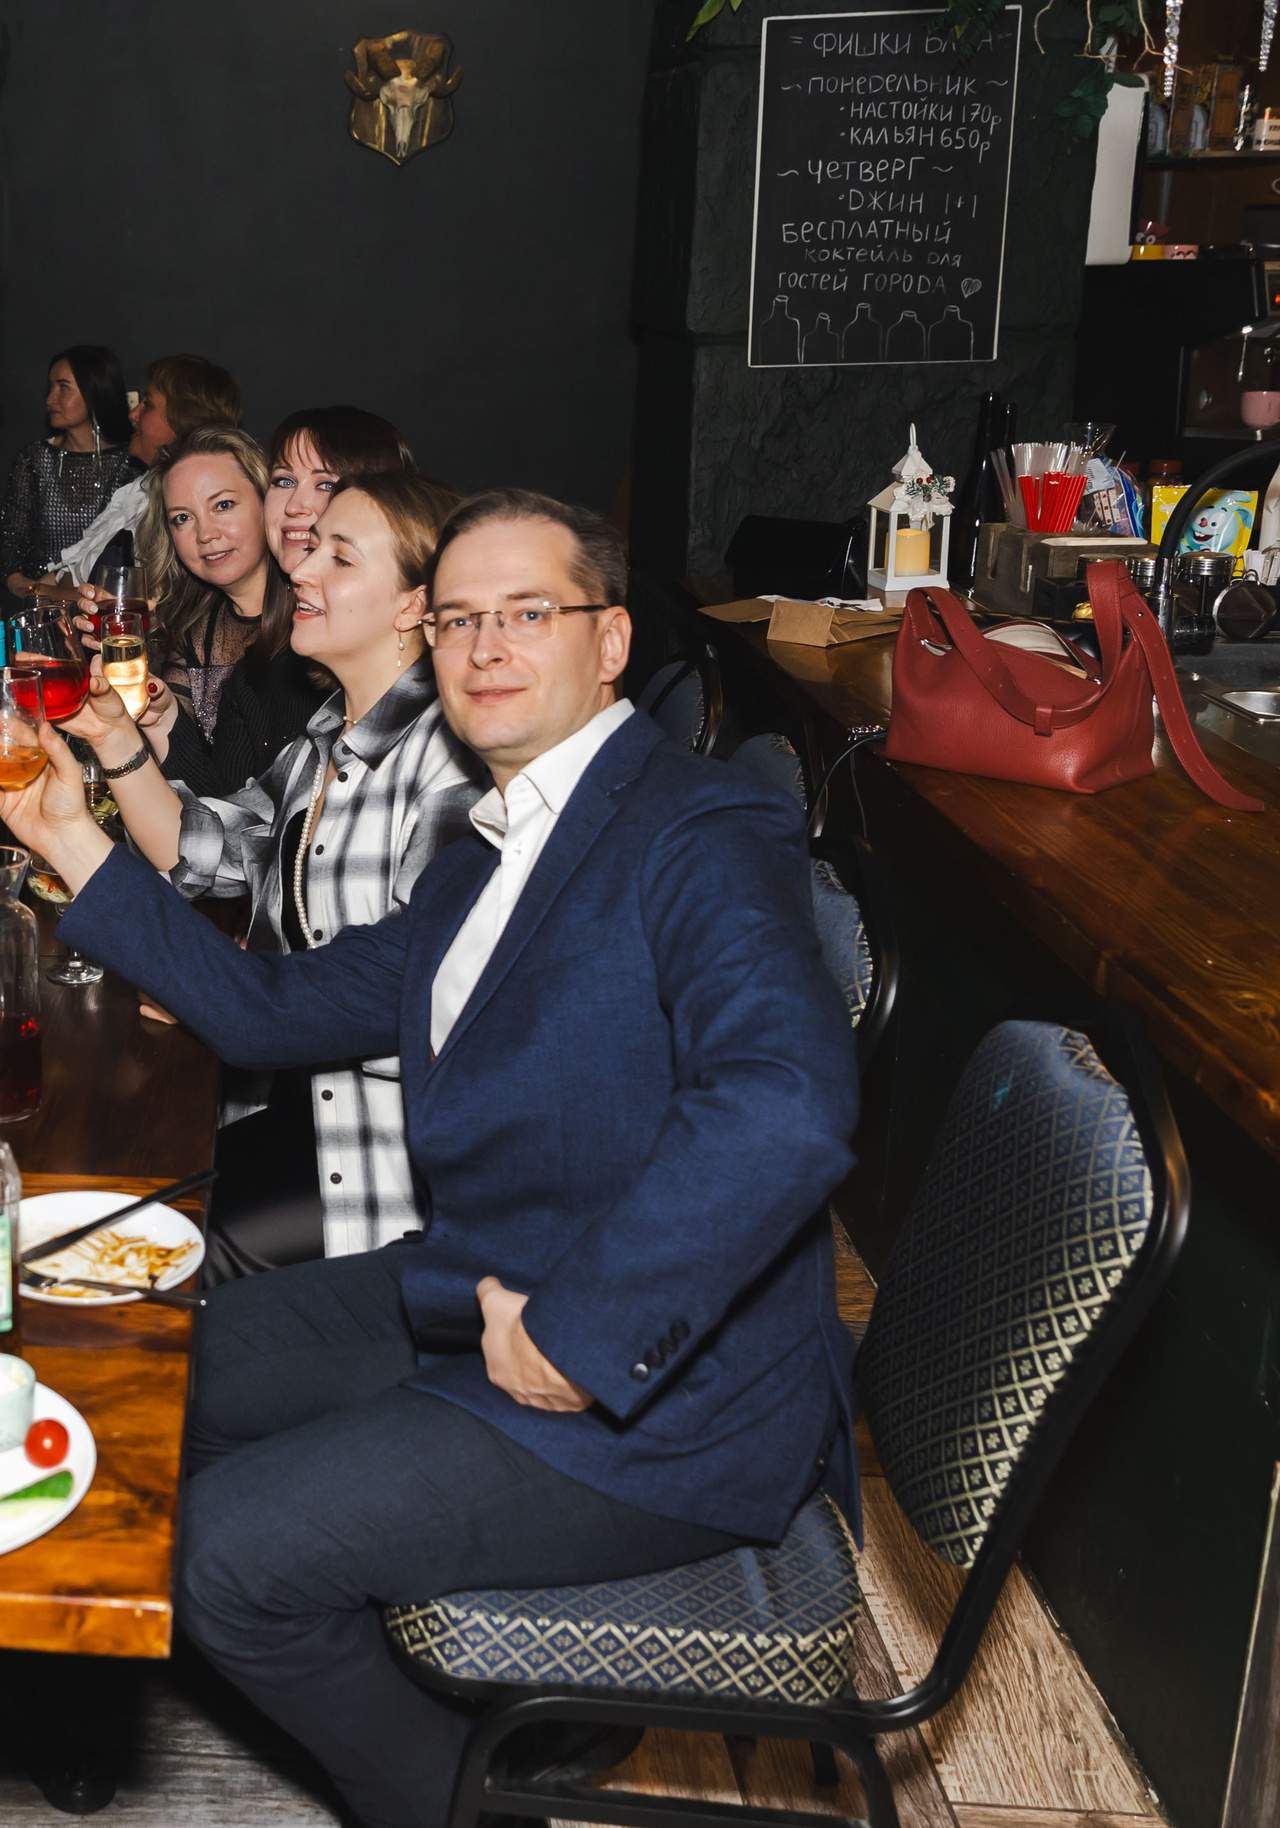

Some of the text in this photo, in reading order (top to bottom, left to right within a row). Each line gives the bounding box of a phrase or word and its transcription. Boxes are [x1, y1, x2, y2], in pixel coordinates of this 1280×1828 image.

[925, 31, 994, 54] БАА
[850, 96, 953, 122] НАСТОЙКИ
[850, 126, 934, 147] КАЛЬЯН
